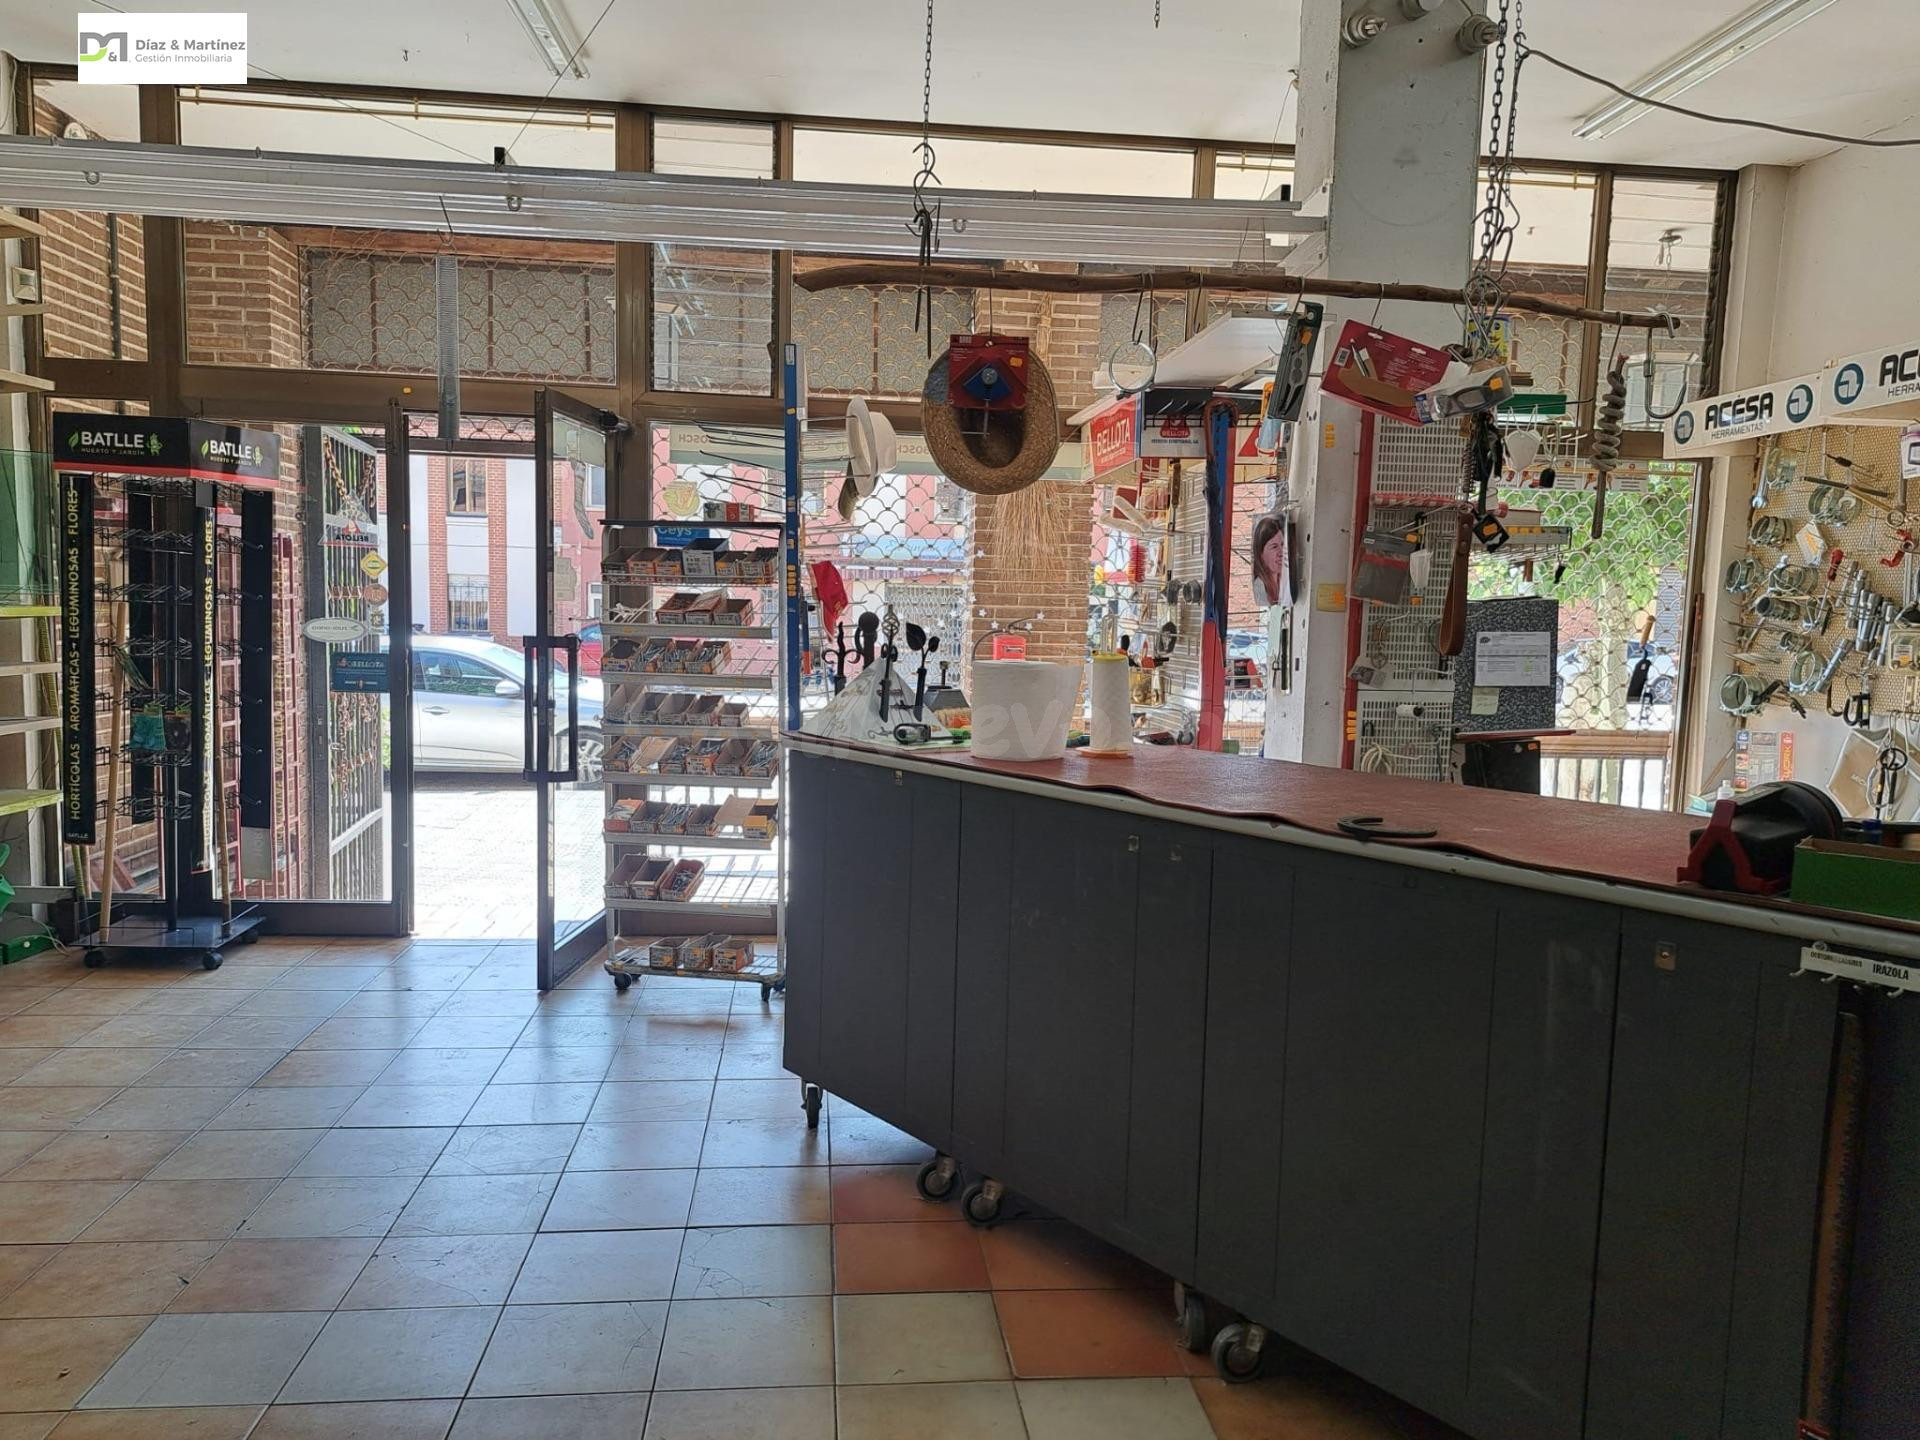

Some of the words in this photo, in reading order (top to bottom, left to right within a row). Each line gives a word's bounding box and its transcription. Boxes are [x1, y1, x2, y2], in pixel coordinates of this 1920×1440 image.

[1879, 349, 1920, 386] AC
[81, 431, 145, 448] BATLLE
[210, 439, 252, 459] BATLLE
[1096, 416, 1131, 457] BELLOTA
[1710, 423, 1765, 440] HERRAMIENTAS
[67, 489, 79, 535] FLORES
[204, 520, 213, 565] FLORES
[68, 549, 80, 639] LEGUMINOSAS
[204, 577, 213, 667] LEGUMINOSAS
[68, 650, 80, 731] AROMÁTICAS
[69, 743, 81, 820] HORTÍCOLAS
[1872, 963, 1910, 980] IRAZOLA
